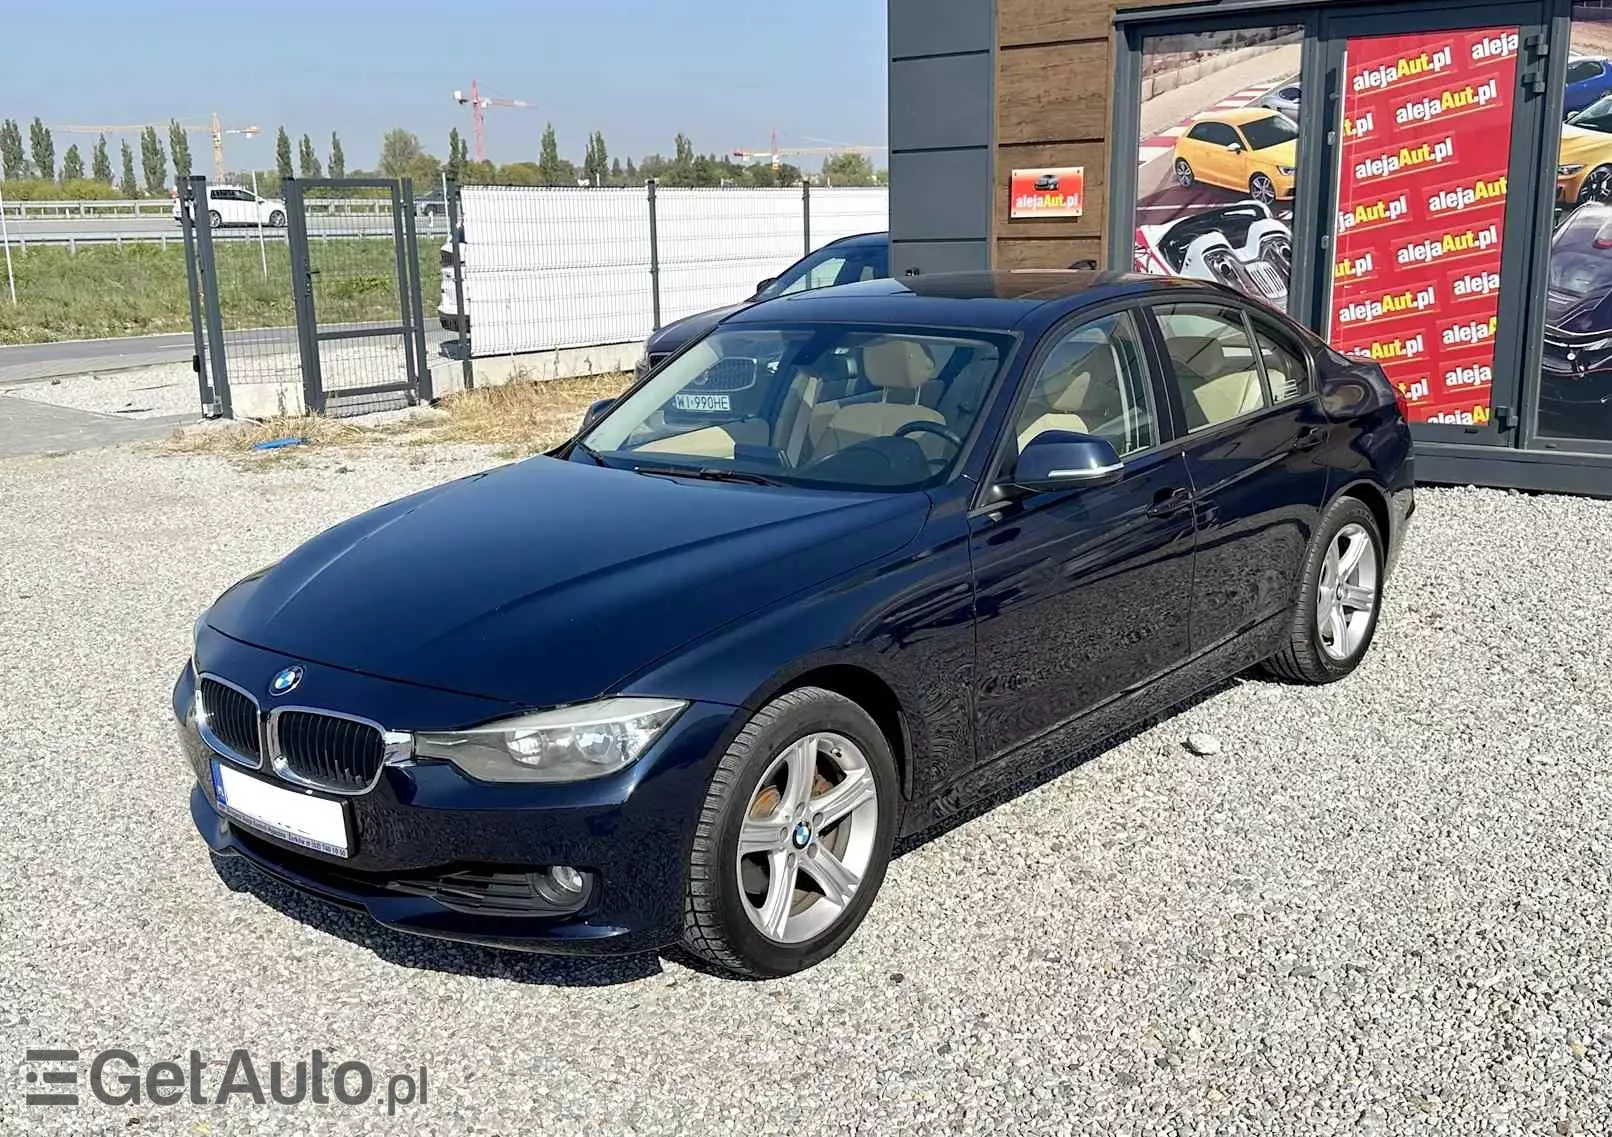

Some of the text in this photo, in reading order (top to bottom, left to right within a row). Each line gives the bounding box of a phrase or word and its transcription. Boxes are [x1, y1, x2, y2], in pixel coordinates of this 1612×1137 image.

[1353, 47, 1451, 91] alejaAut.pl
[1395, 80, 1497, 121] alejaAut.pl
[1355, 138, 1453, 178] alejaAut.pl
[1016, 193, 1078, 209] alejaAut.pl
[1397, 225, 1497, 264] alejaAut.pl
[1339, 287, 1436, 323] alejaAut.pl
